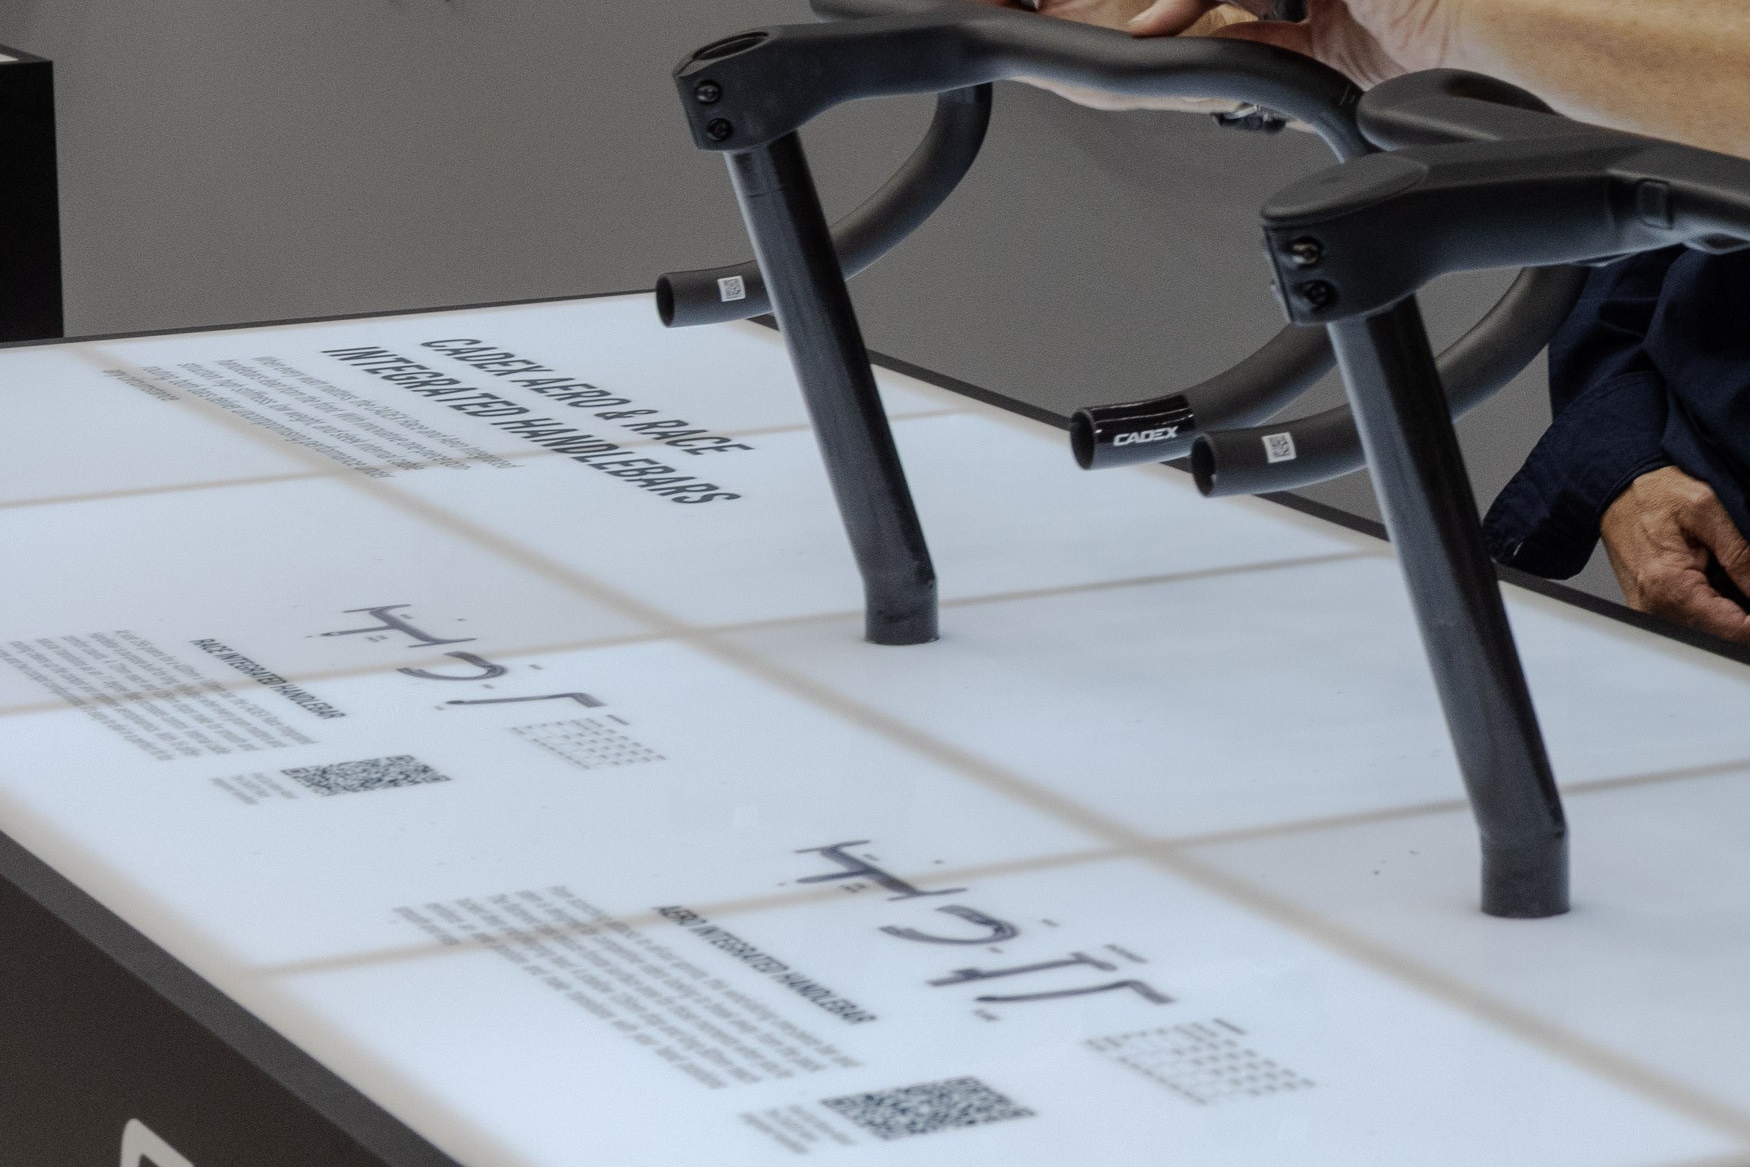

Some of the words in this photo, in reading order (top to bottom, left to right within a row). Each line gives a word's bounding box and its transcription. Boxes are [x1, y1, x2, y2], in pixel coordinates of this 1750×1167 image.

[417, 338, 553, 376] CADEX
[511, 375, 634, 408] AERO
[320, 346, 534, 417] INTEGRATED
[492, 418, 744, 504] HANDLEBARS
[608, 408, 659, 421] &
[622, 420, 753, 455] RACE
[1113, 426, 1179, 447] CADEX
[190, 638, 232, 653] RACE
[214, 652, 287, 685] INTEGRATED
[269, 684, 346, 719] HANDLEBAR
